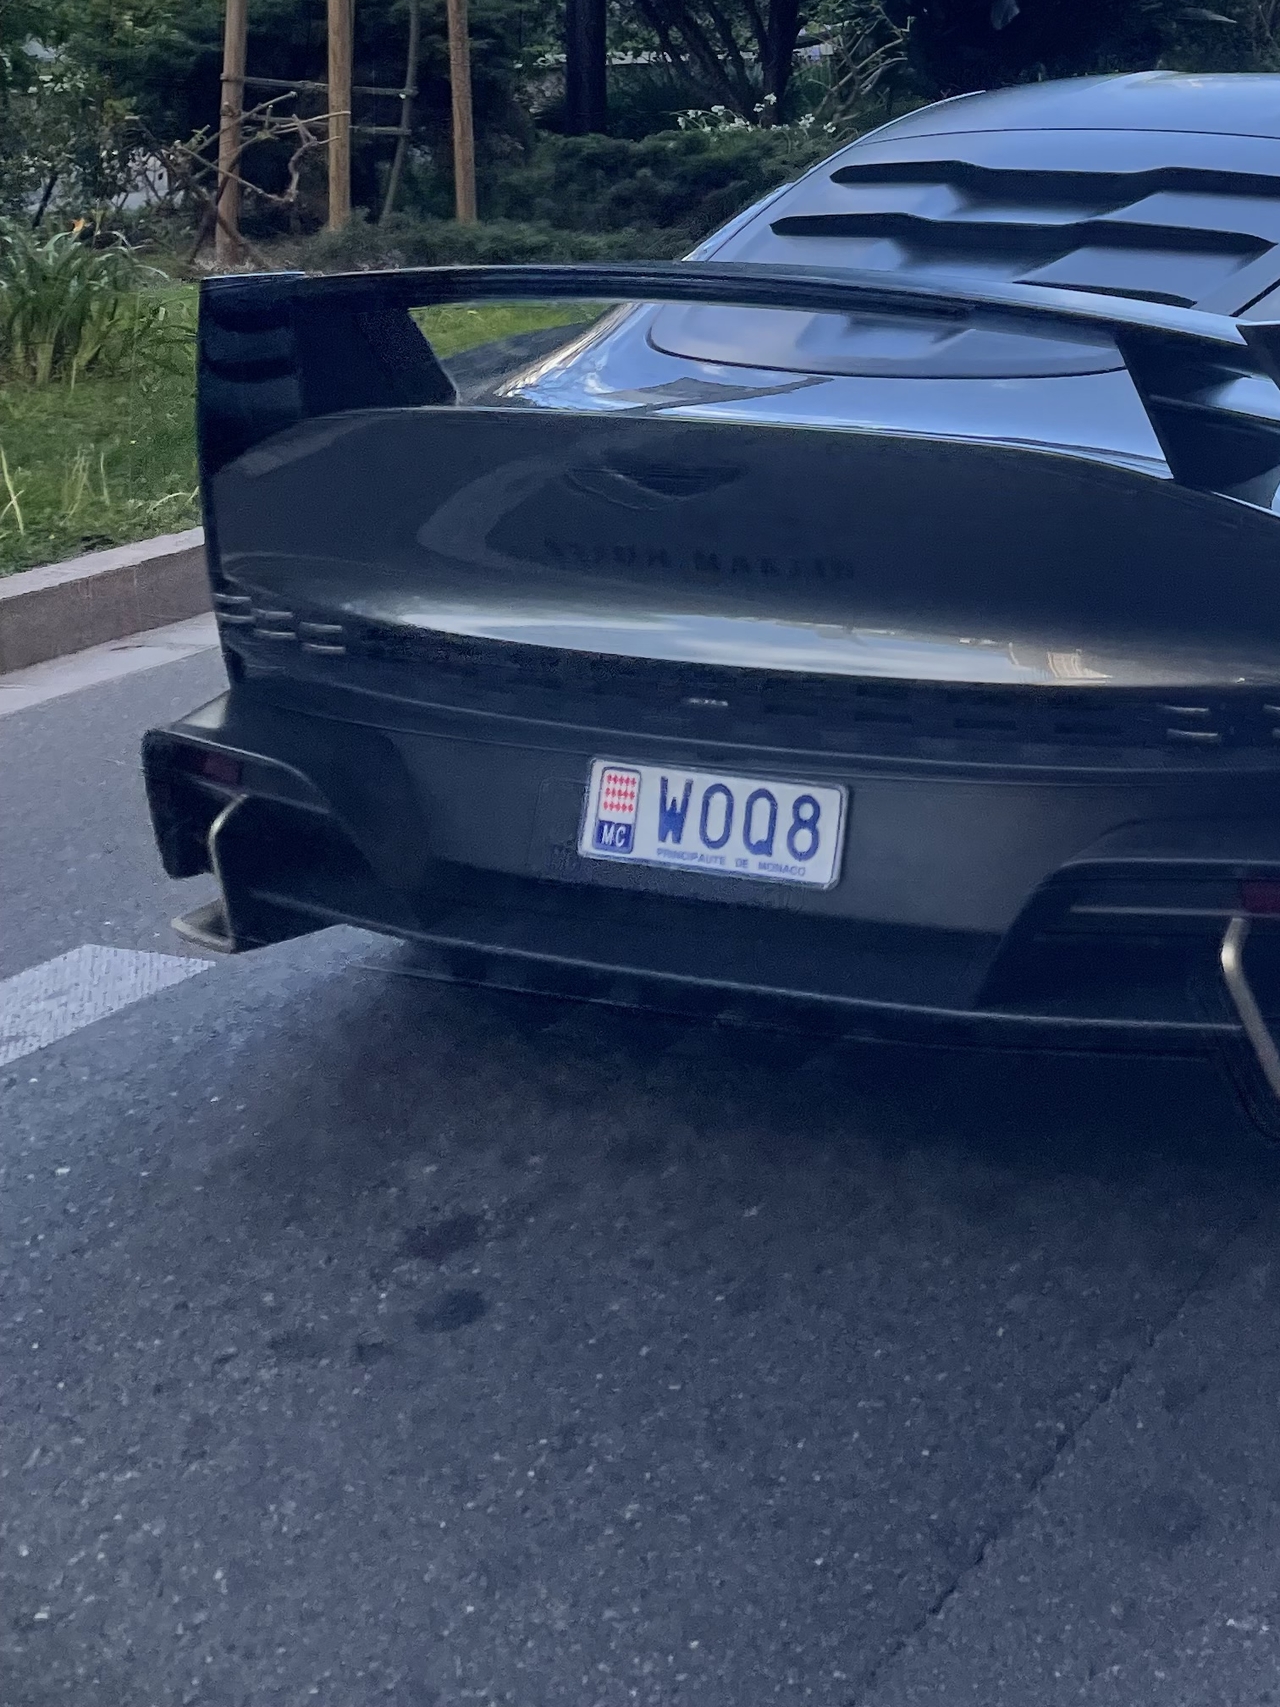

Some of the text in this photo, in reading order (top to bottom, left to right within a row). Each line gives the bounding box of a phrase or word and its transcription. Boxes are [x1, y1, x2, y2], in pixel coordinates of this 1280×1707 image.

[601, 824, 627, 848] MC
[656, 847, 806, 877] PRINCIPAUTE DE MONACO
